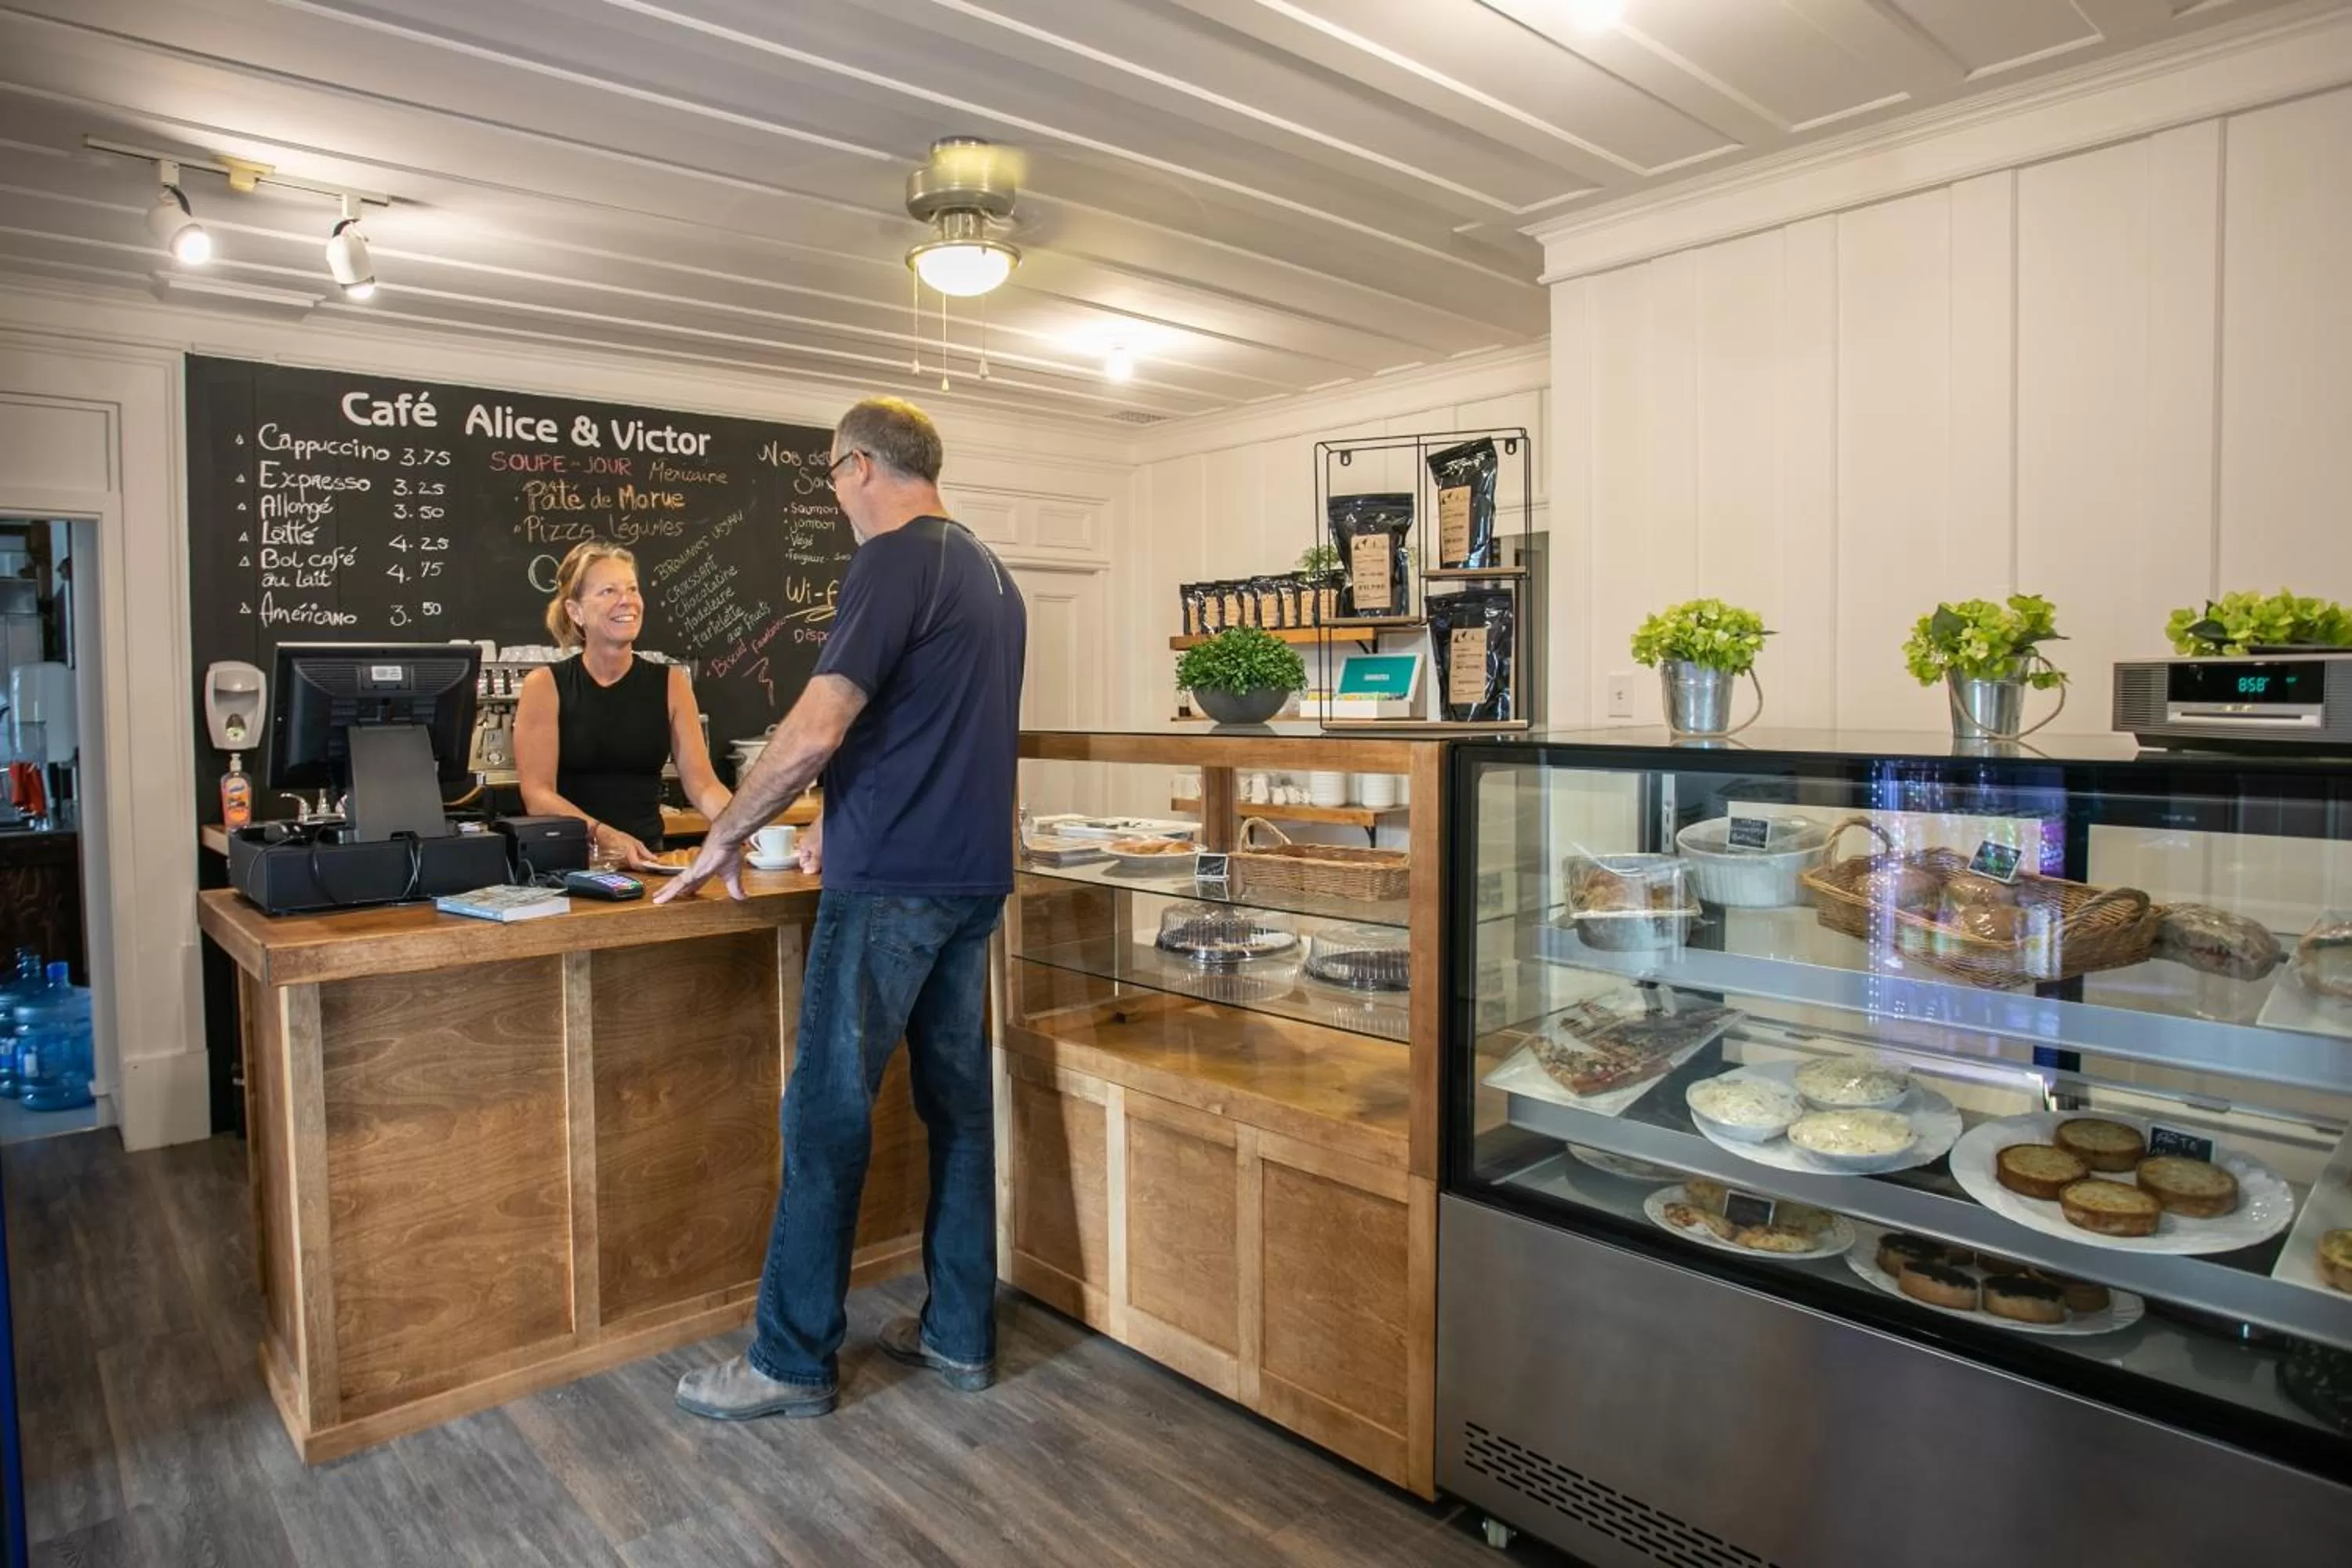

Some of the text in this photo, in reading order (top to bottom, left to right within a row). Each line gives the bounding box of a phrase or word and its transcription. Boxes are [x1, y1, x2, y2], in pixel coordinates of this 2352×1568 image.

[342, 391, 712, 457] Café Alice & Victor
[258, 423, 452, 466] Cappuccino 3.75
[757, 440, 803, 467] Nos
[260, 459, 447, 503] Expresso 3.25
[521, 478, 687, 513] Pâté de Morue
[260, 492, 445, 524] Allongé 3.50
[262, 520, 320, 546] Latté
[523, 514, 597, 543] Pizza
[308, 546, 358, 572] café
[261, 572, 290, 587] au
[259, 590, 358, 627] Américano
